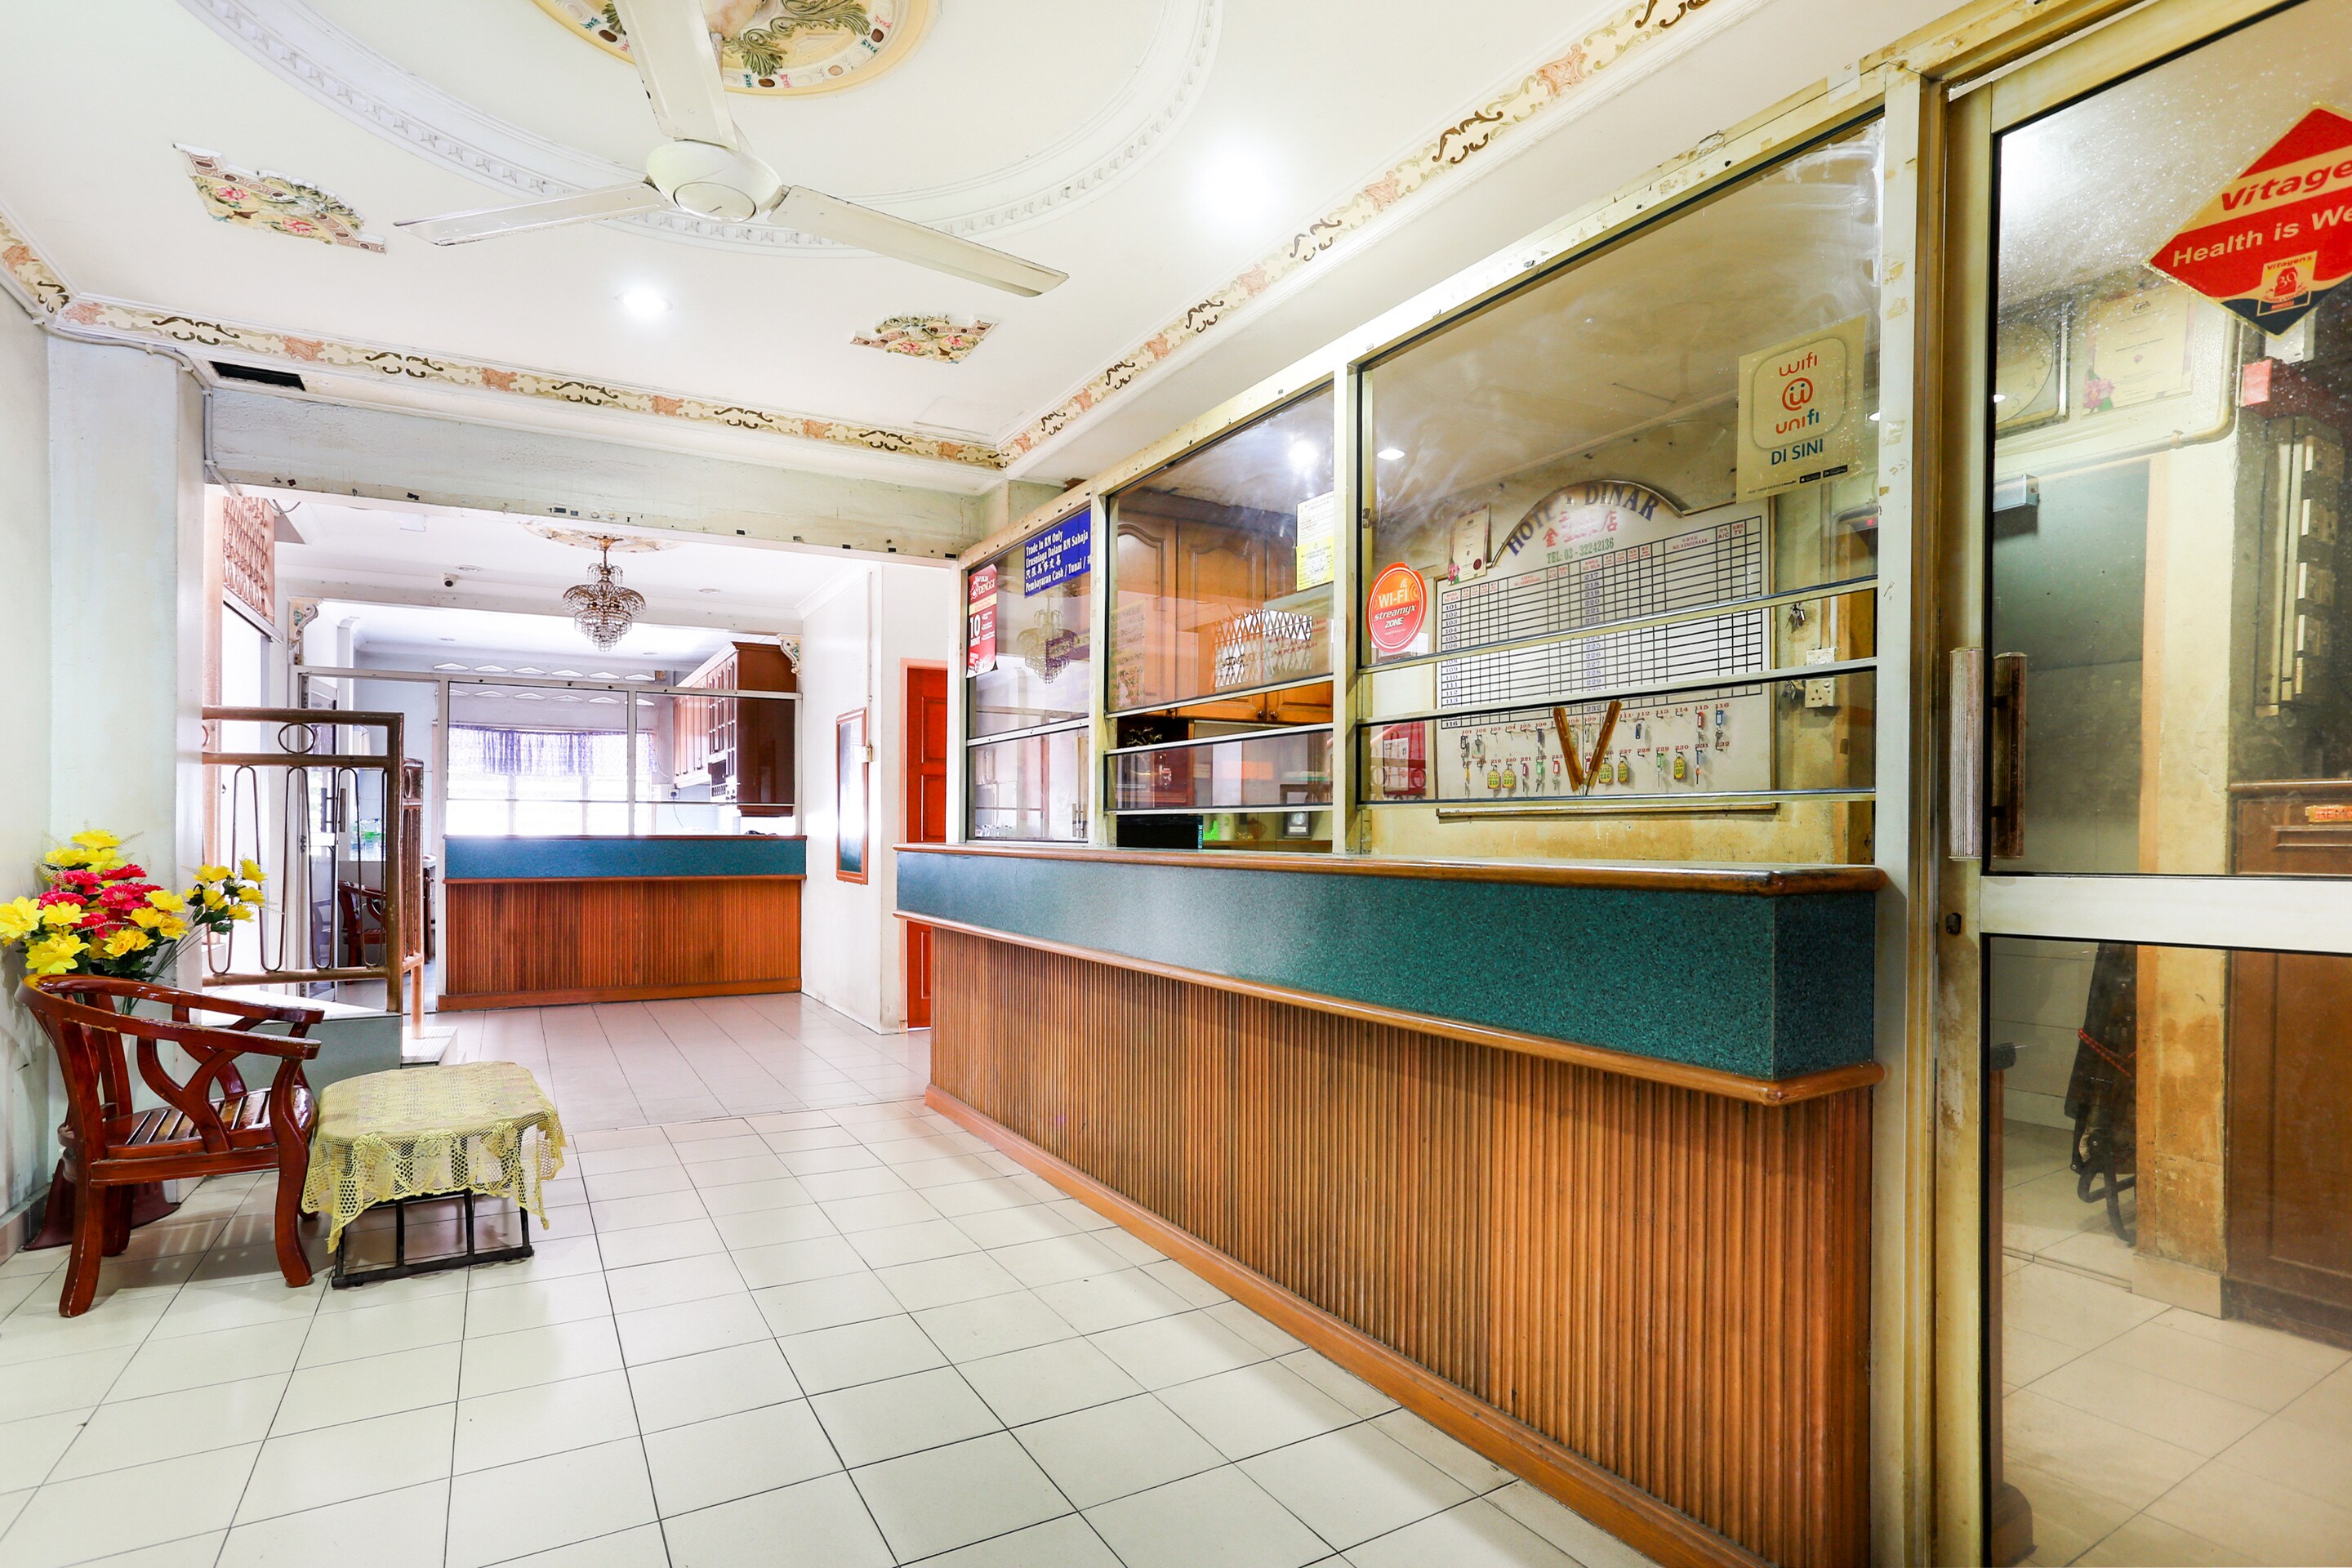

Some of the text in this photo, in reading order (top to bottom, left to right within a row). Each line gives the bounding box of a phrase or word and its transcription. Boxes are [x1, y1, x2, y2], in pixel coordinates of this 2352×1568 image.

[2172, 230, 2263, 268] Health
[2274, 222, 2299, 241] is
[2278, 271, 2297, 289] 30
[1779, 351, 1818, 376] wifi
[1775, 408, 1820, 434] unifi
[1771, 439, 1824, 466] DI SINI
[1584, 483, 1659, 522] DINAR
[1026, 530, 1063, 557] Trade In RM Only
[1026, 529, 1089, 568] Urusniaga Dalam RM Sahaja
[1564, 548, 1574, 560] 03
[1579, 537, 1615, 556] 32242136
[1025, 574, 1052, 593] Pembayaran
[1052, 567, 1064, 581] Cash
[1068, 557, 1082, 574] Tunai
[1584, 572, 1599, 581] 217
[1584, 581, 1600, 589] 218
[1373, 604, 1416, 621] streamyx
[1384, 617, 1404, 629] ZONE
[1585, 607, 1600, 615] 221
[1585, 616, 1600, 624] 222
[969, 613, 981, 639] 10
